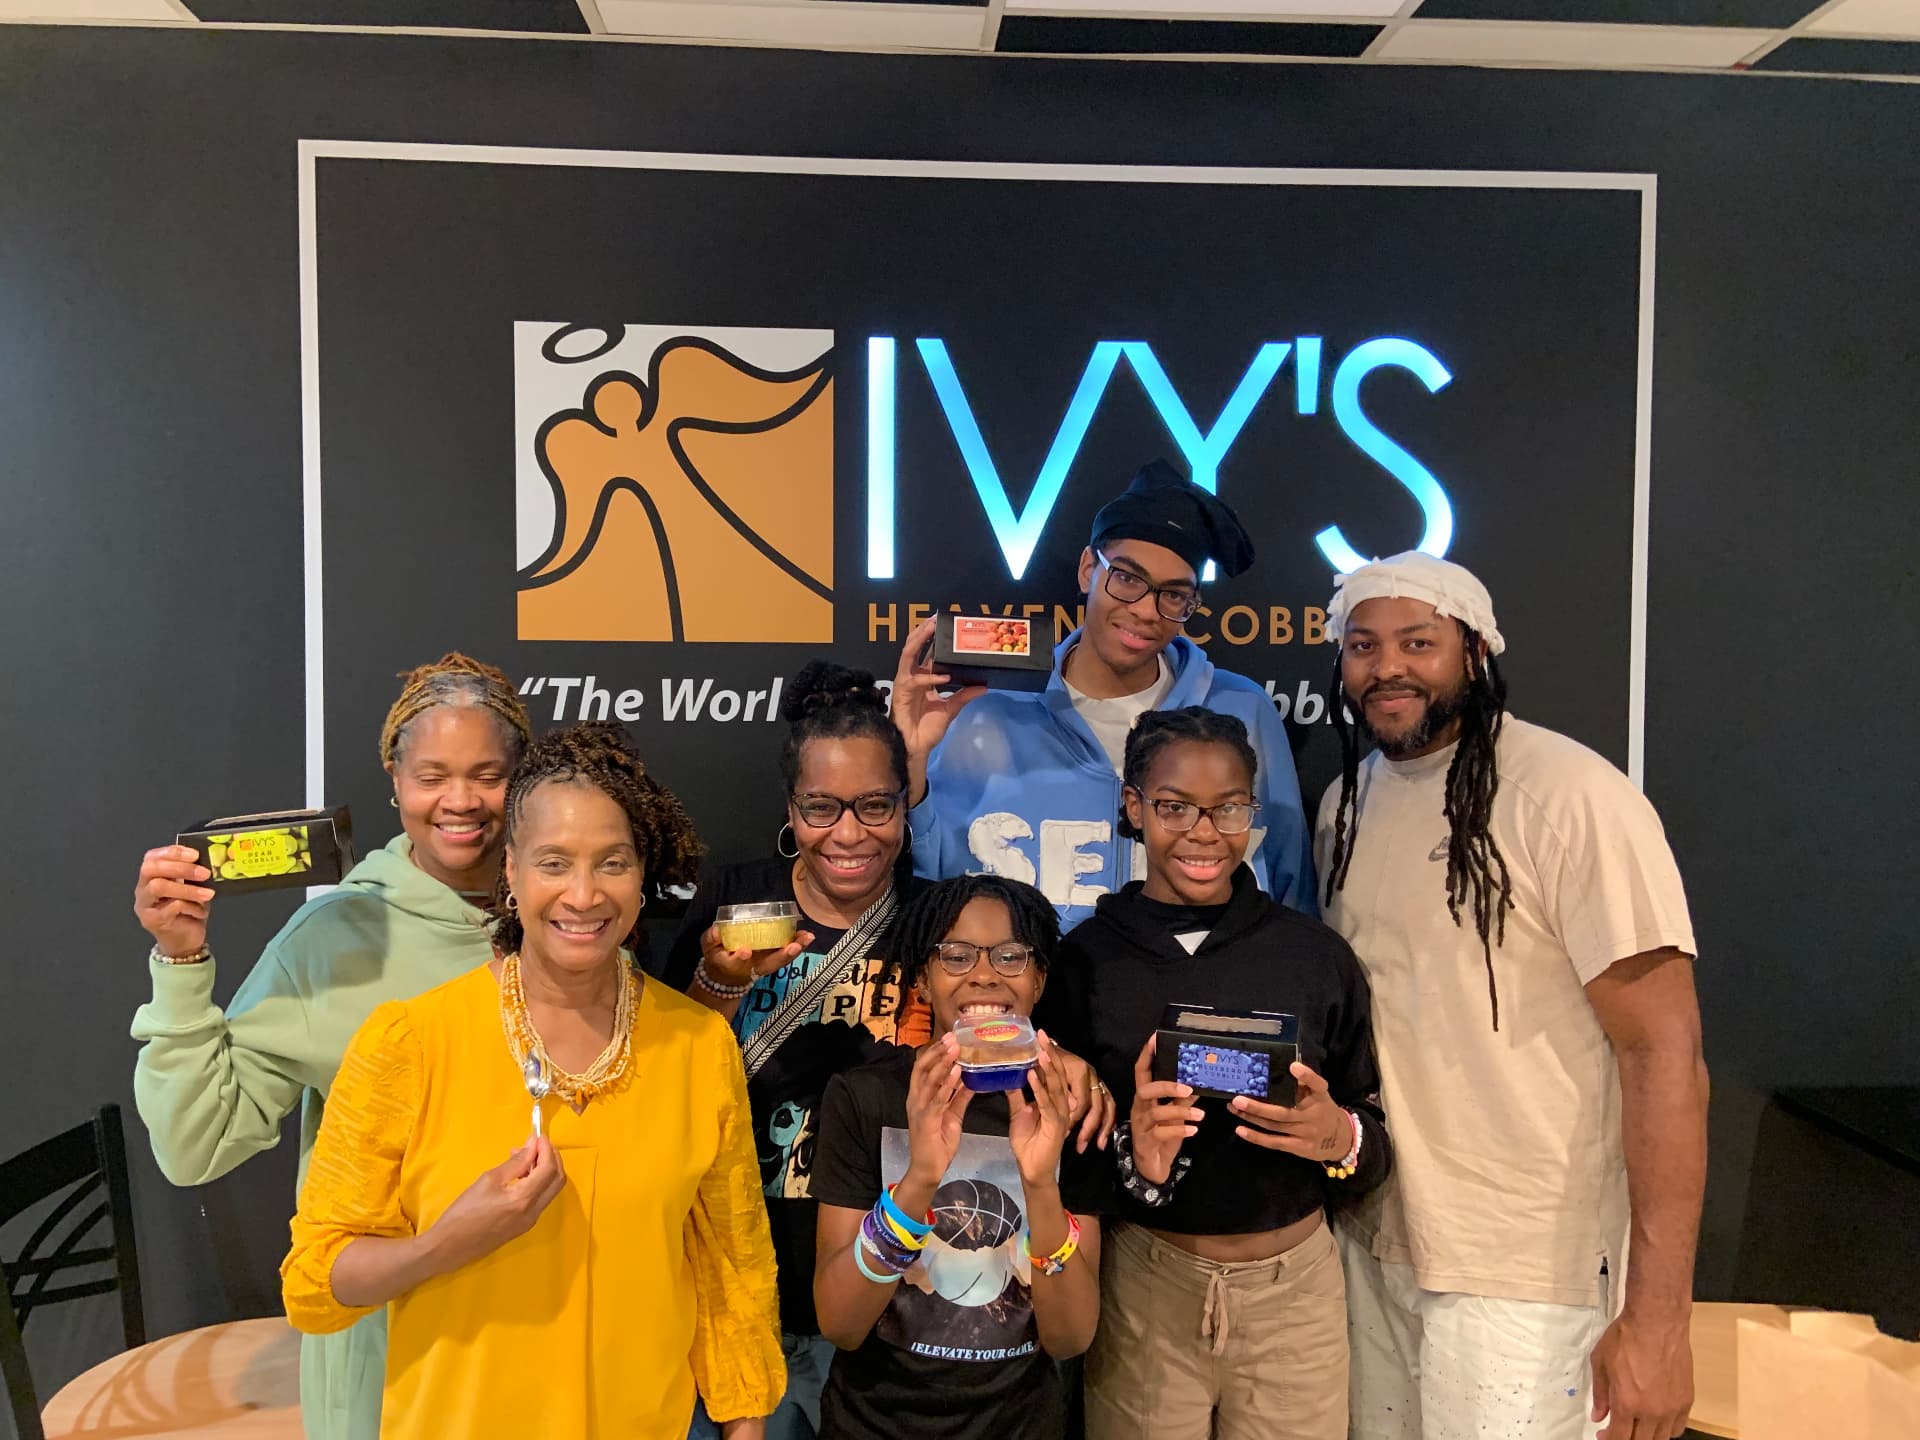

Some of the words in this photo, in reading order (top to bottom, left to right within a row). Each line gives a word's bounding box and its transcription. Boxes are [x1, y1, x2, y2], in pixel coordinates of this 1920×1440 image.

[867, 336, 1454, 581] IVY'S
[752, 989, 894, 1017] DPE
[975, 1349, 1005, 1360] YOUR
